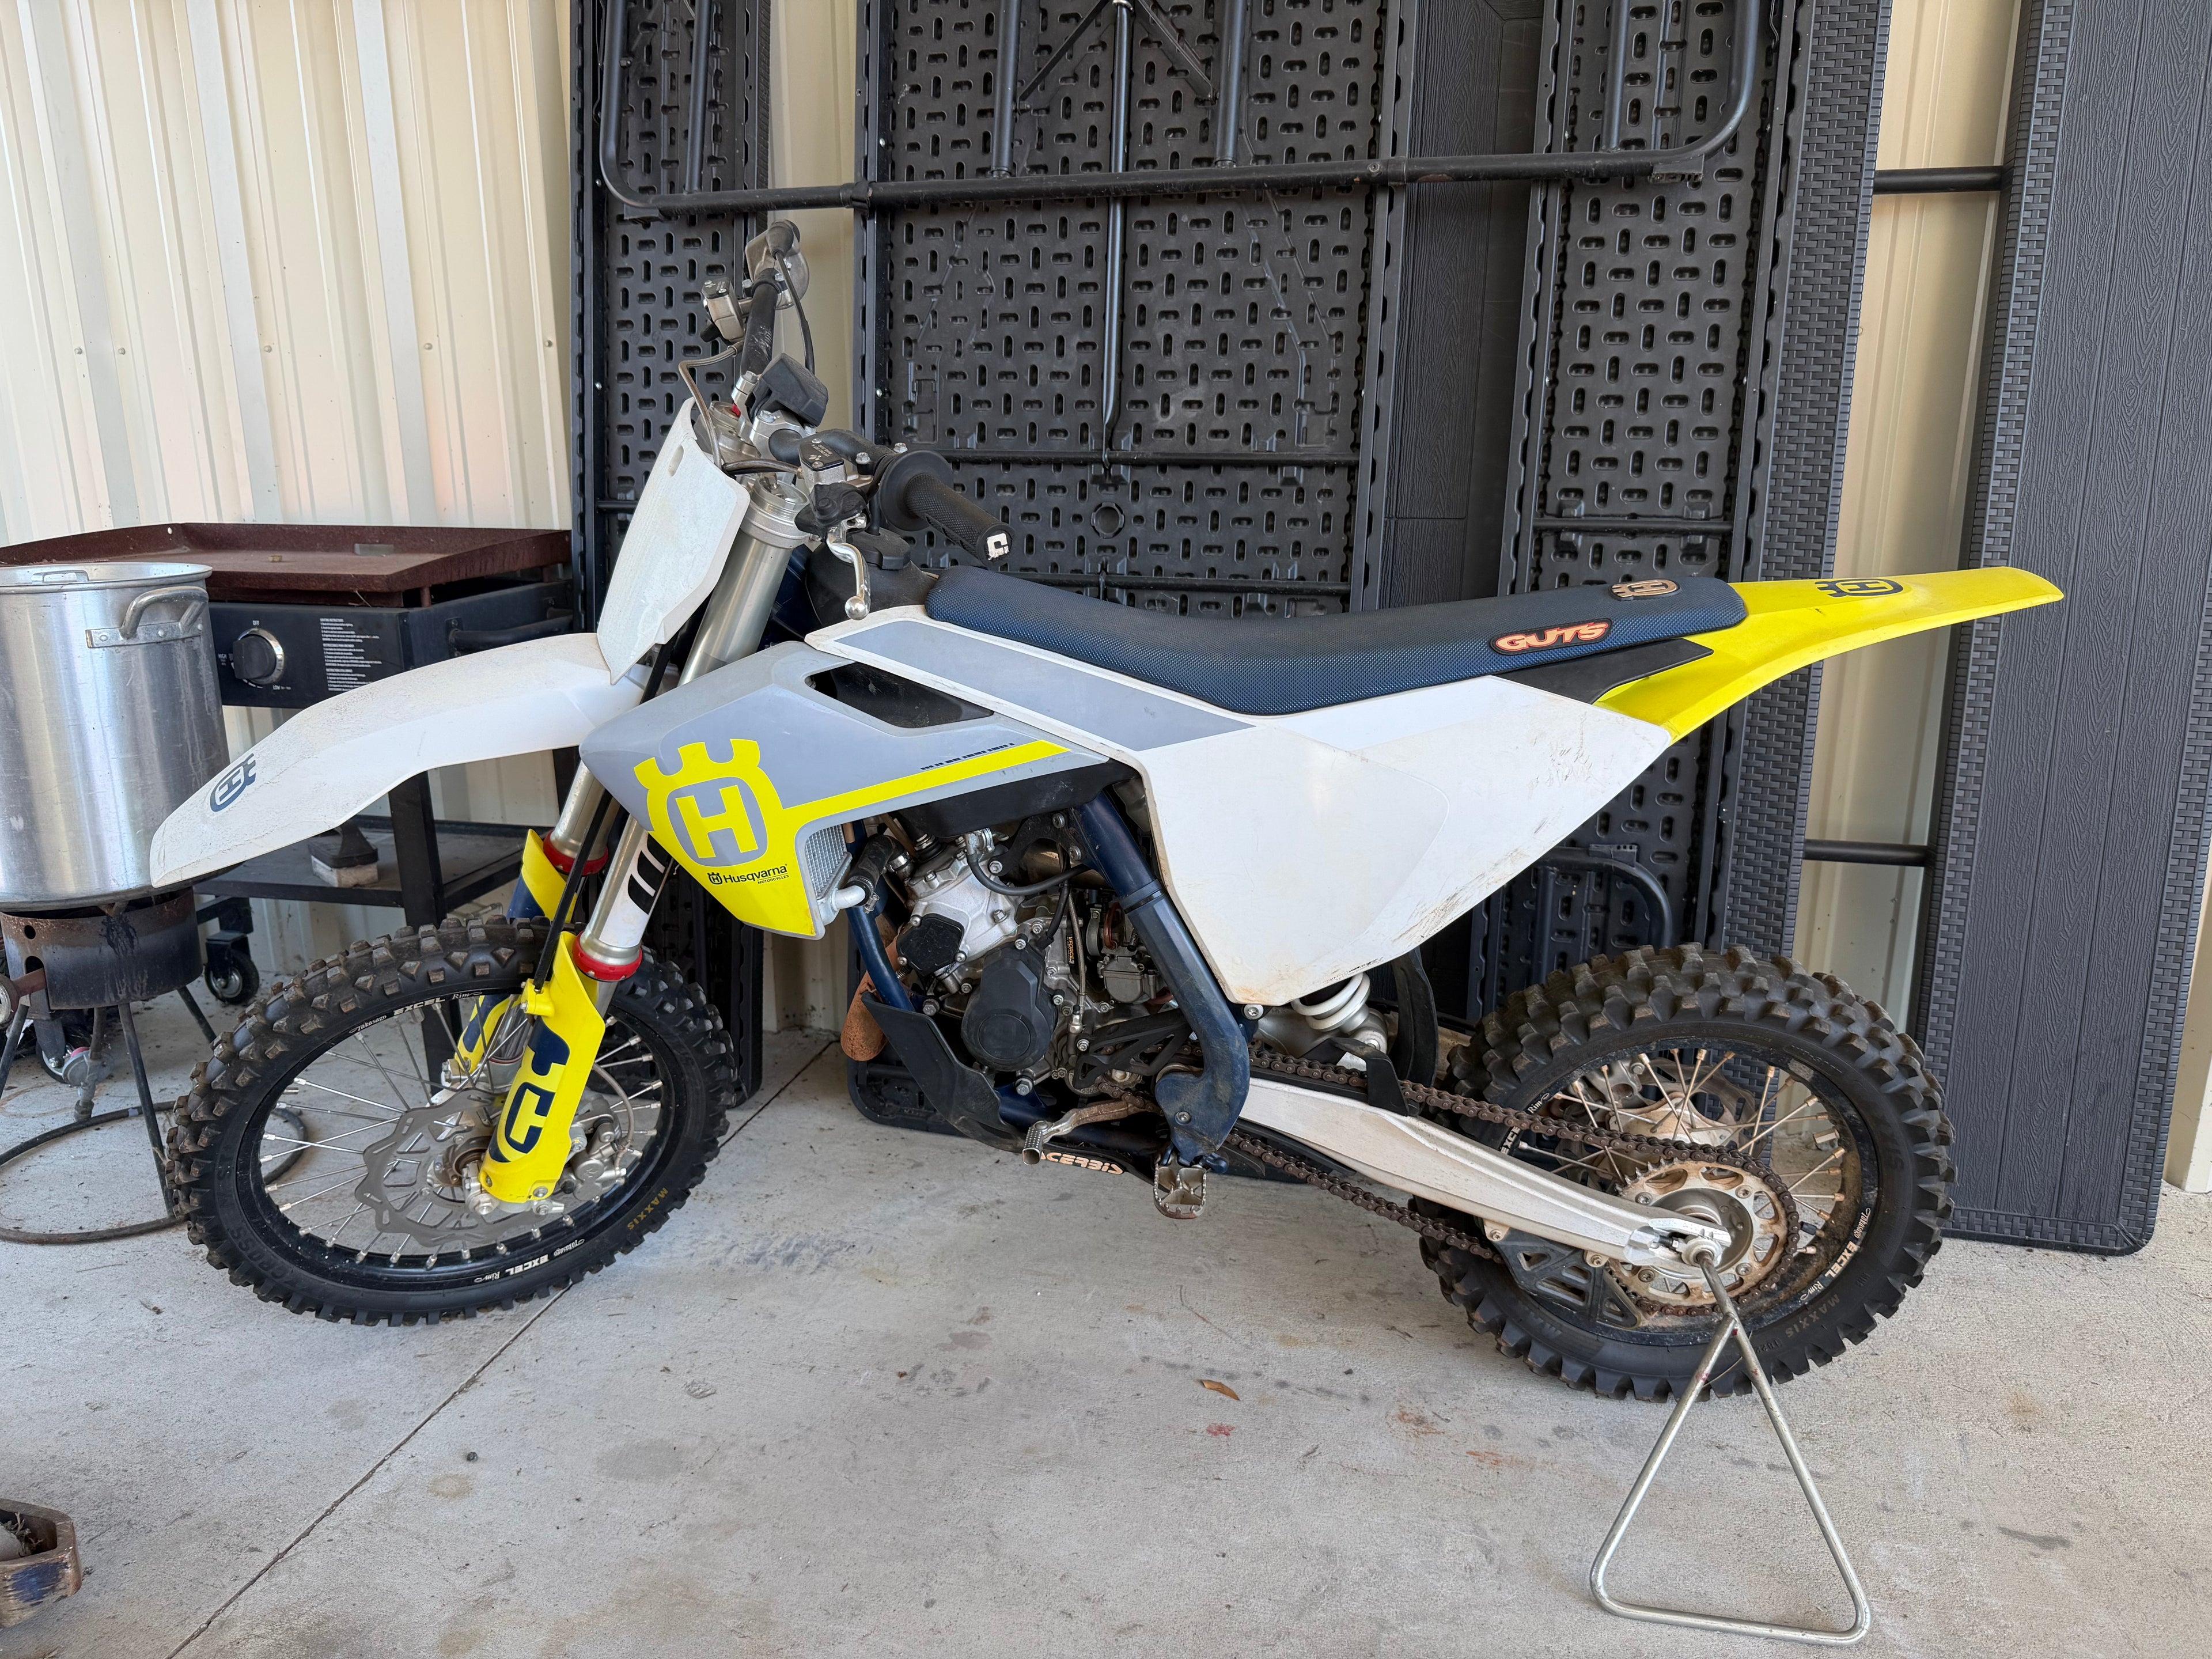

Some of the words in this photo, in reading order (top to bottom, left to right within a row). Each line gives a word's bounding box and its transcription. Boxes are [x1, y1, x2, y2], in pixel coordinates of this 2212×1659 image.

[1496, 622, 1608, 652] GUTS
[724, 866, 787, 883] Husqvarna
[757, 874, 789, 884] MOTORCYCLES
[393, 998, 445, 1016] EXCEL
[1500, 1126, 1521, 1155] EXCE
[627, 1187, 668, 1230] MAXXIS
[505, 1254, 550, 1275] EXCEL
[1824, 1240, 1860, 1278] EXCEL
[1785, 1294, 1840, 1338] MAXXIS
